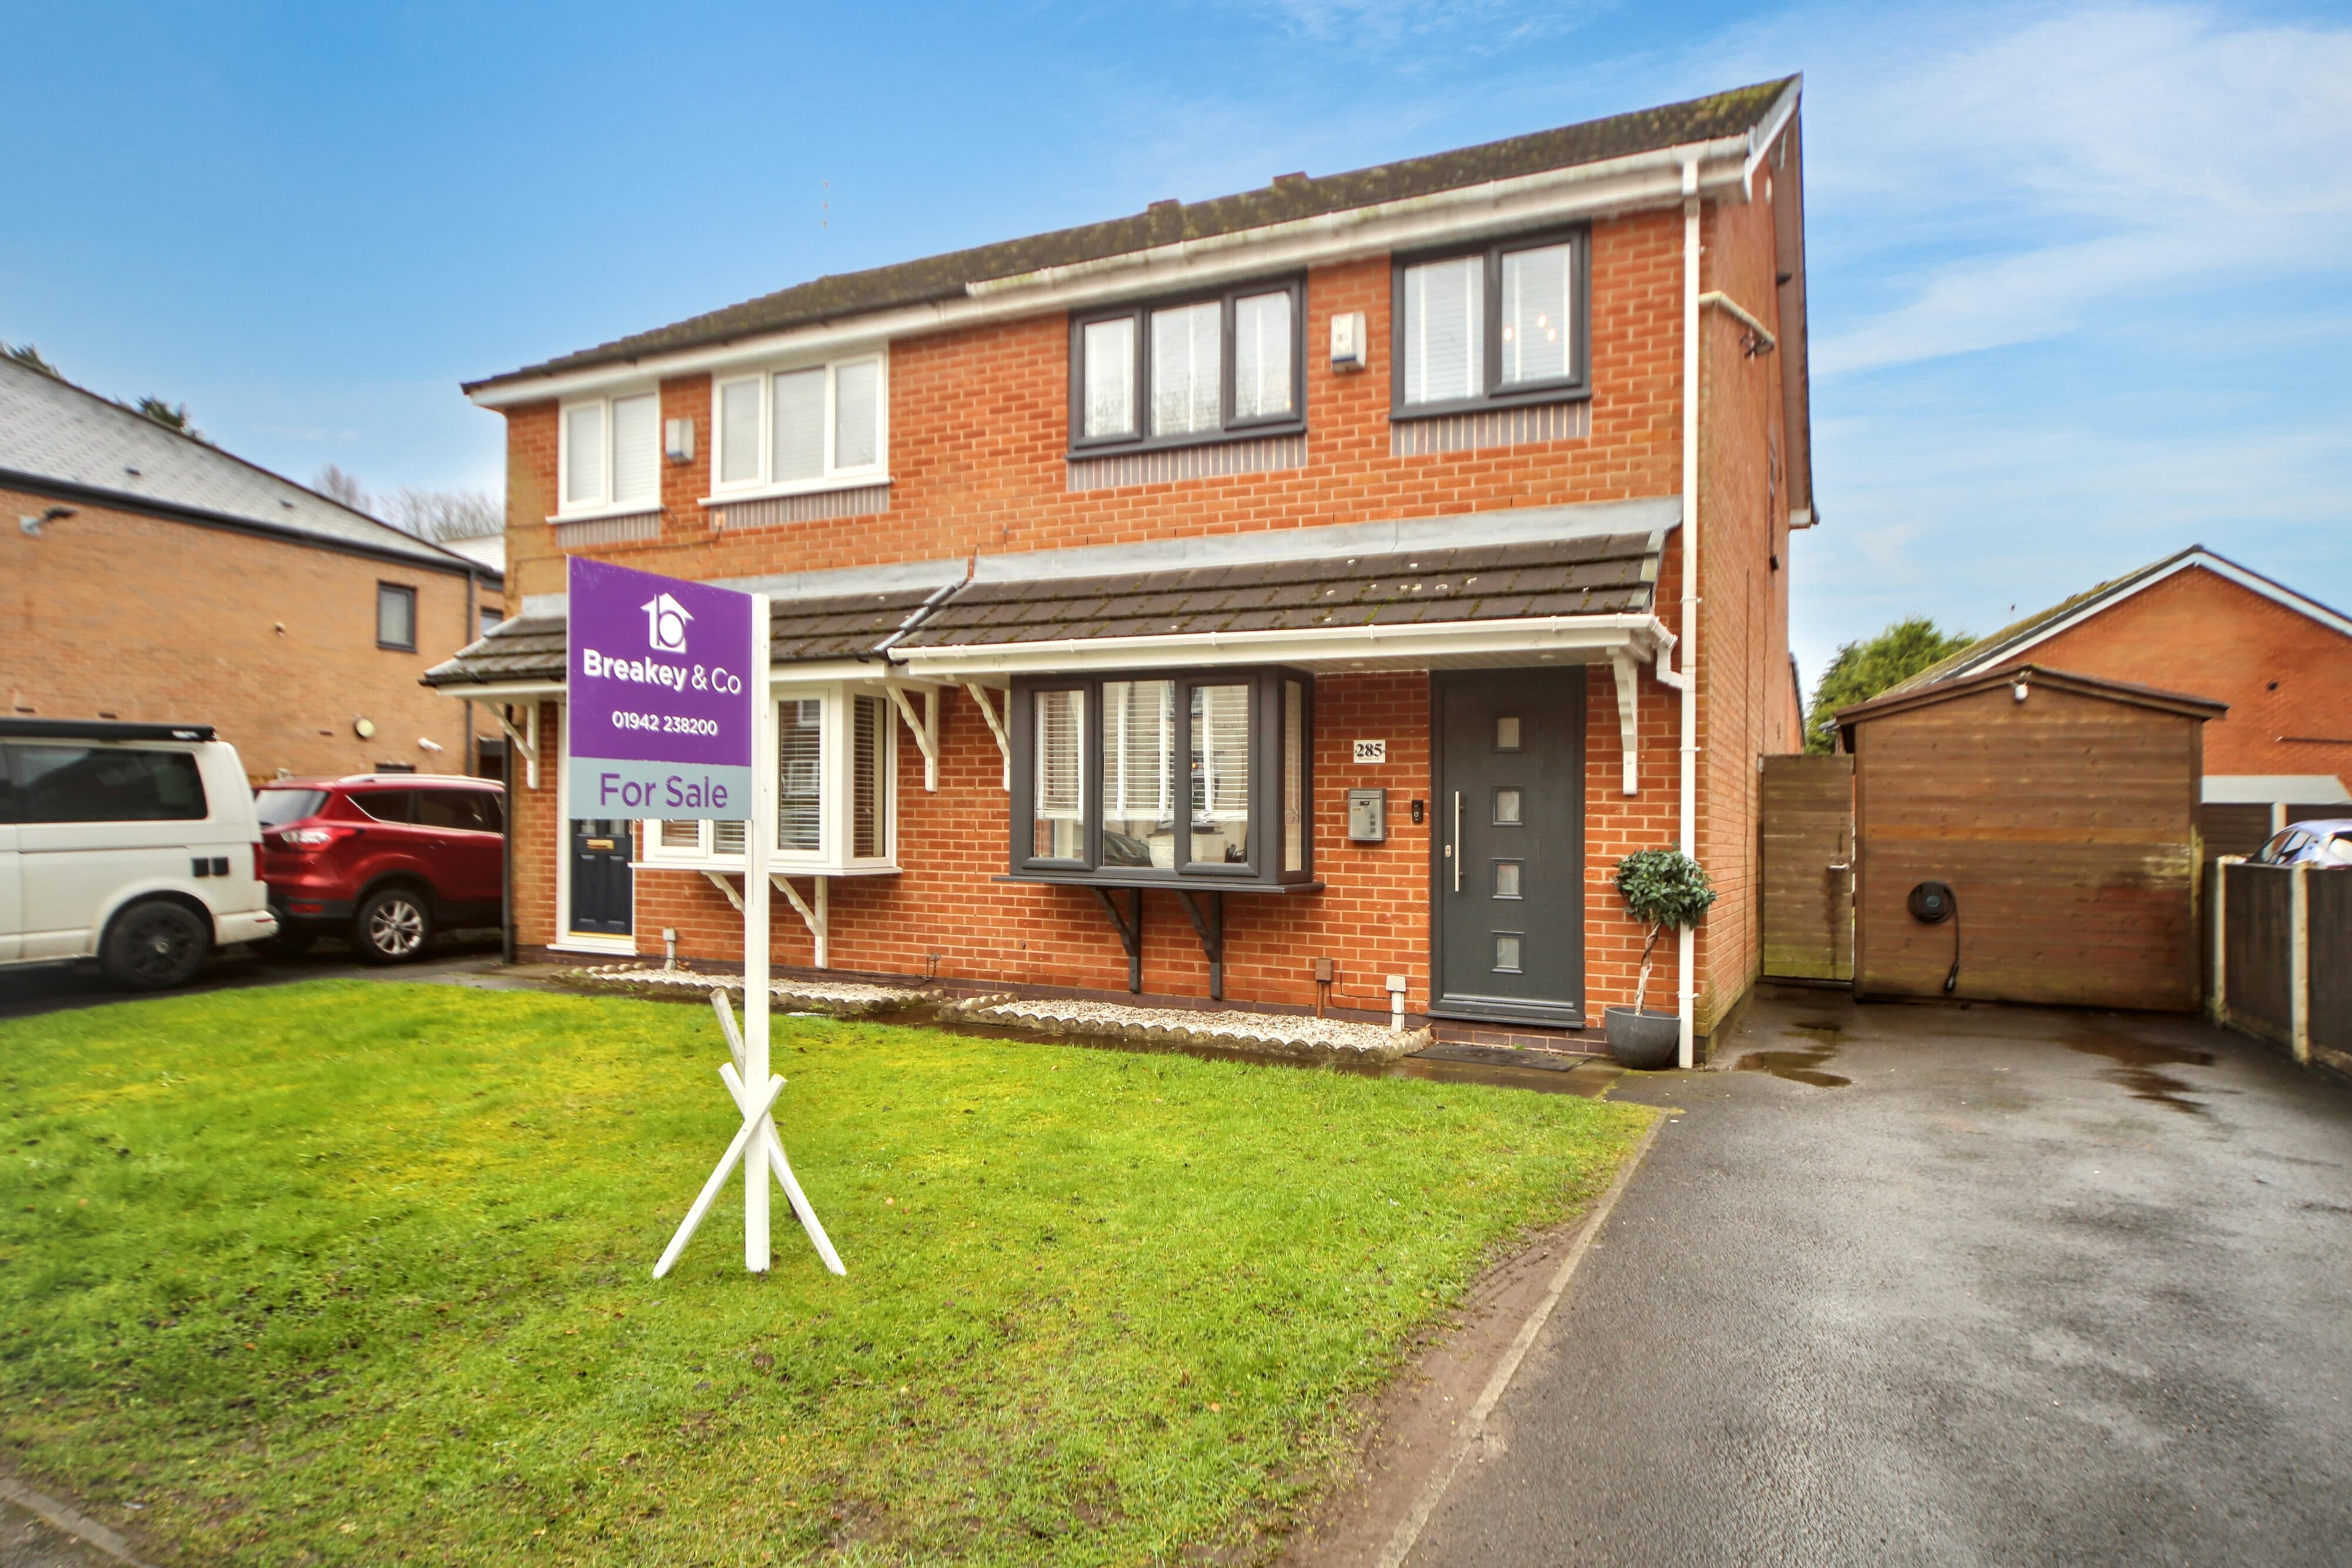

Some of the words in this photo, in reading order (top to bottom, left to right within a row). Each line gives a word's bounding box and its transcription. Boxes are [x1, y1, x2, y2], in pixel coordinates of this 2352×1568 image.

[583, 648, 687, 691] Breakey
[691, 664, 708, 691] &
[711, 667, 741, 694] Co
[612, 710, 659, 731] 01942
[663, 716, 718, 736] 238200
[1356, 743, 1382, 757] 285
[600, 773, 656, 807] For
[666, 775, 728, 808] Sale
